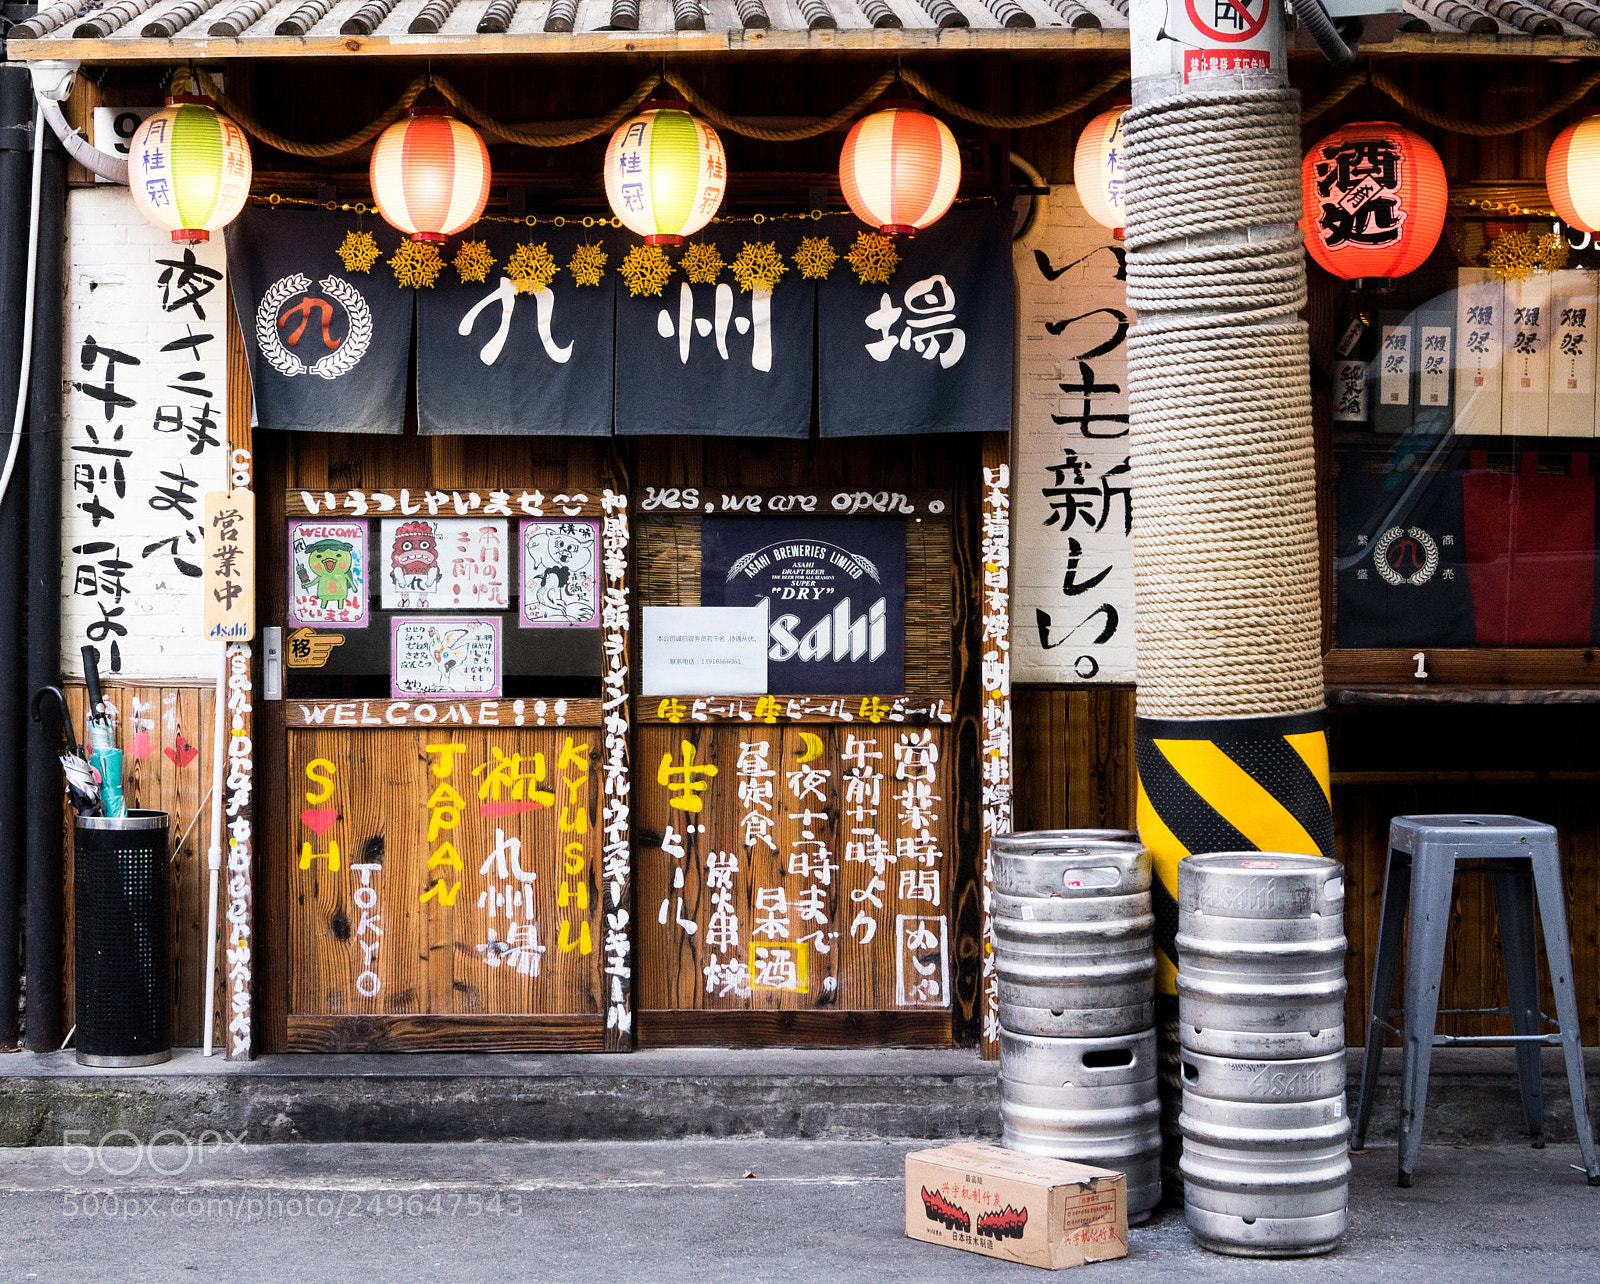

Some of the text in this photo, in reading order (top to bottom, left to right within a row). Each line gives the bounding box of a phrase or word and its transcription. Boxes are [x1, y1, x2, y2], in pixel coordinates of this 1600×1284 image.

[143, 118, 170, 208] 月桂冠
[619, 121, 648, 213] 月桂冠
[697, 124, 725, 215] 月桂冠
[299, 527, 362, 539] WELCOME
[722, 492, 761, 512] we
[768, 491, 817, 511] are
[212, 508, 244, 611] 営業中
[744, 544, 863, 580] ASAHI BREWERIES LIMITED
[210, 622, 247, 637] Asahi
[292, 639, 311, 658] 移
[1412, 652, 1428, 678] 1
[472, 746, 555, 807] 祝
[893, 729, 942, 906] 営業時間
[419, 743, 466, 906] JAPAN
[558, 737, 592, 955] KYUSHU
[841, 734, 897, 944] 午前十一時より
[350, 863, 383, 997] TOKYO
